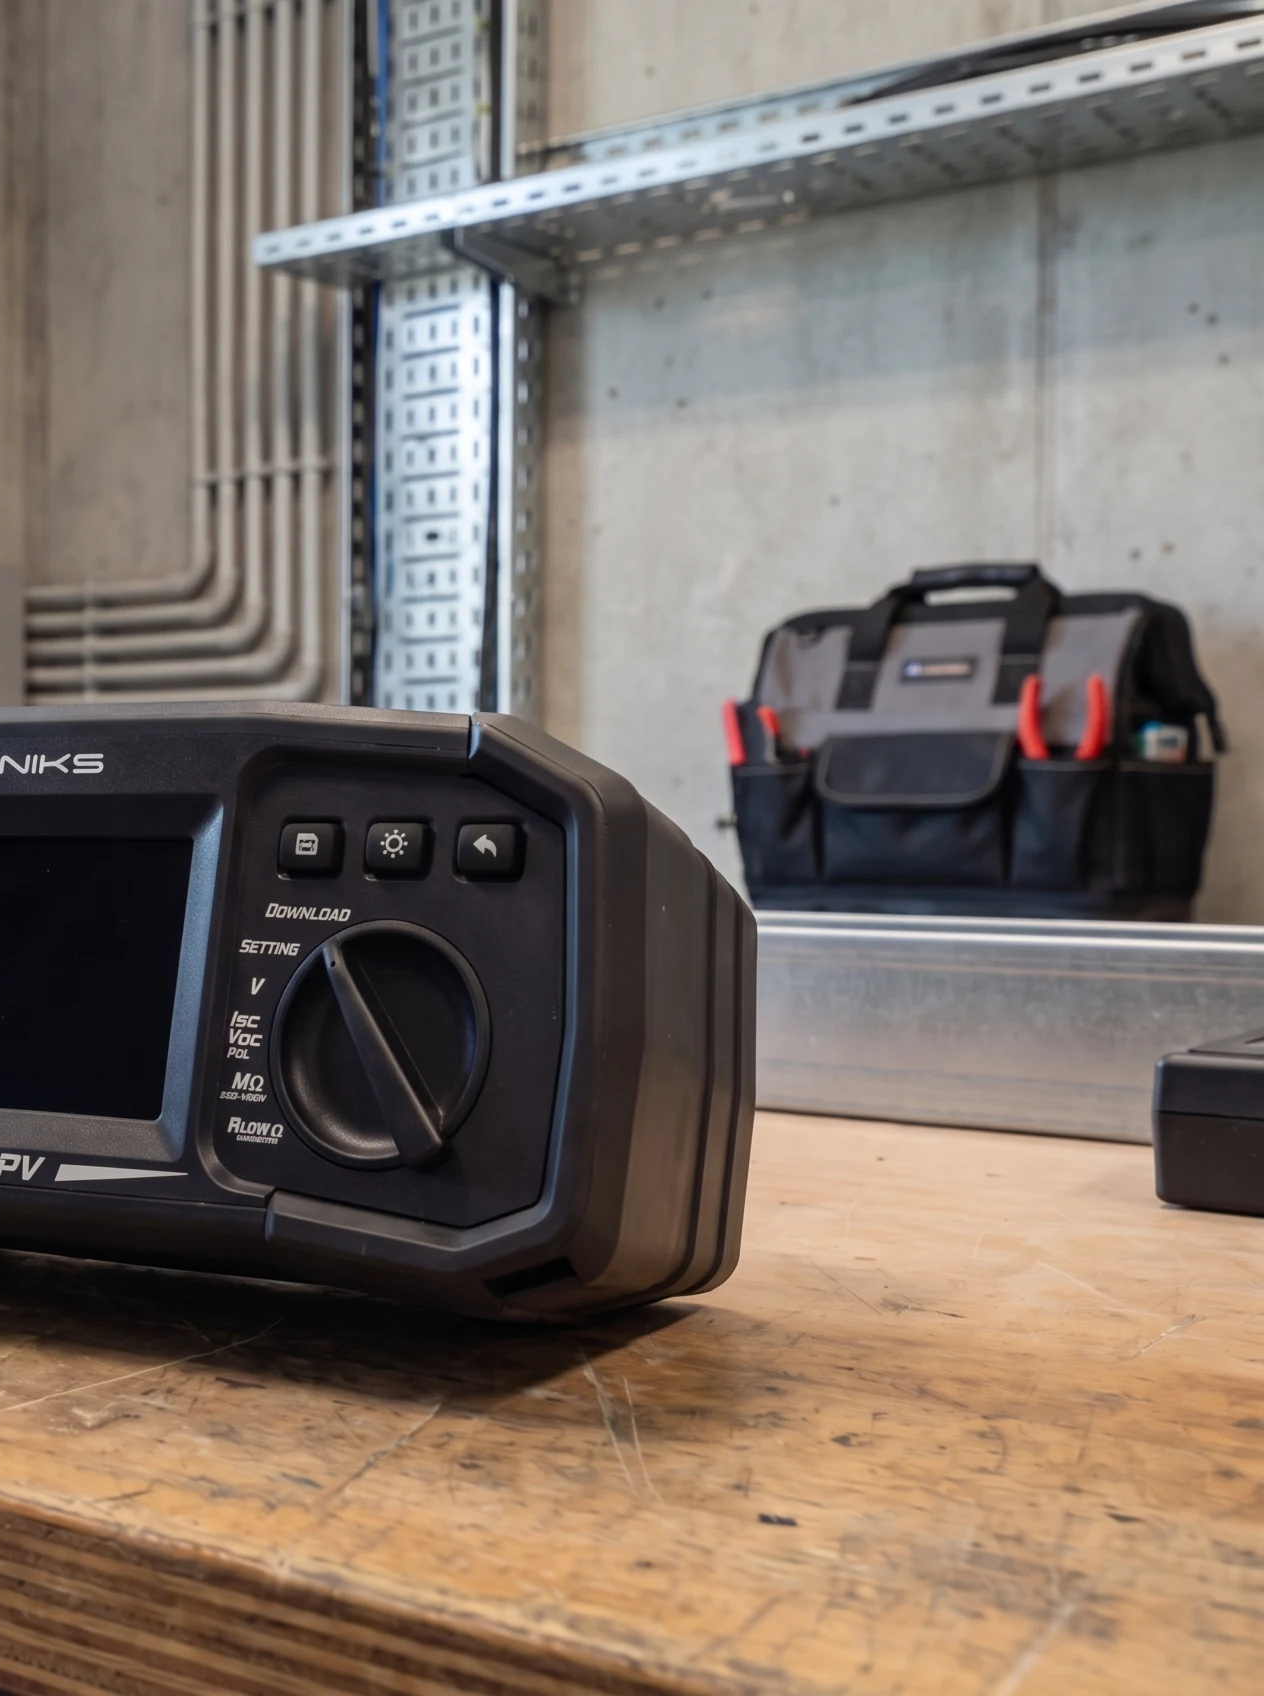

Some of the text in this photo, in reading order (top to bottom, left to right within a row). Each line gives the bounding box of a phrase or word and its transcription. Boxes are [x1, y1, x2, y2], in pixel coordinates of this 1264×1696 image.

[239, 939, 301, 956] SETTING
[251, 977, 266, 996] V
[231, 1071, 265, 1092] MΩ
